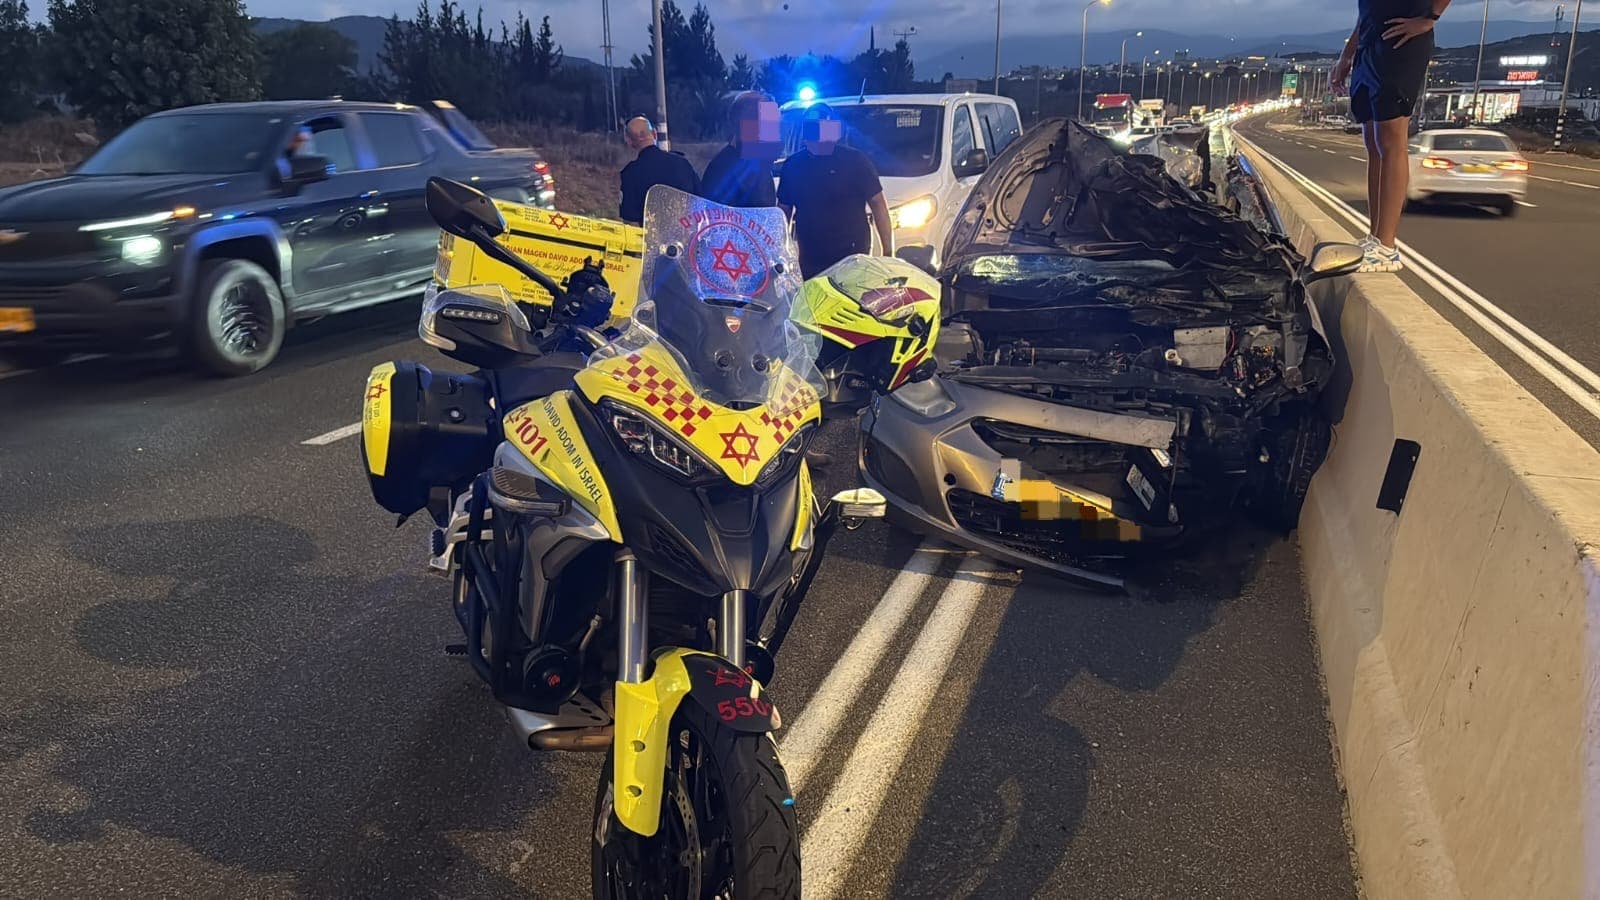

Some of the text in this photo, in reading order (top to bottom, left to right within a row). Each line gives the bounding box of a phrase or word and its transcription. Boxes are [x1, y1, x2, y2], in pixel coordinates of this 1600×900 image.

[748, 219, 775, 246] יחידת
[523, 247, 548, 259] MAGEN
[548, 252, 569, 262] DAVID
[569, 255, 585, 265] ADO
[604, 262, 625, 273] SRAEL
[514, 416, 548, 456] 101
[543, 400, 561, 428] DAVID
[555, 426, 577, 457] ADOM
[572, 454, 584, 469] IN
[578, 466, 603, 505] ISRAEL
